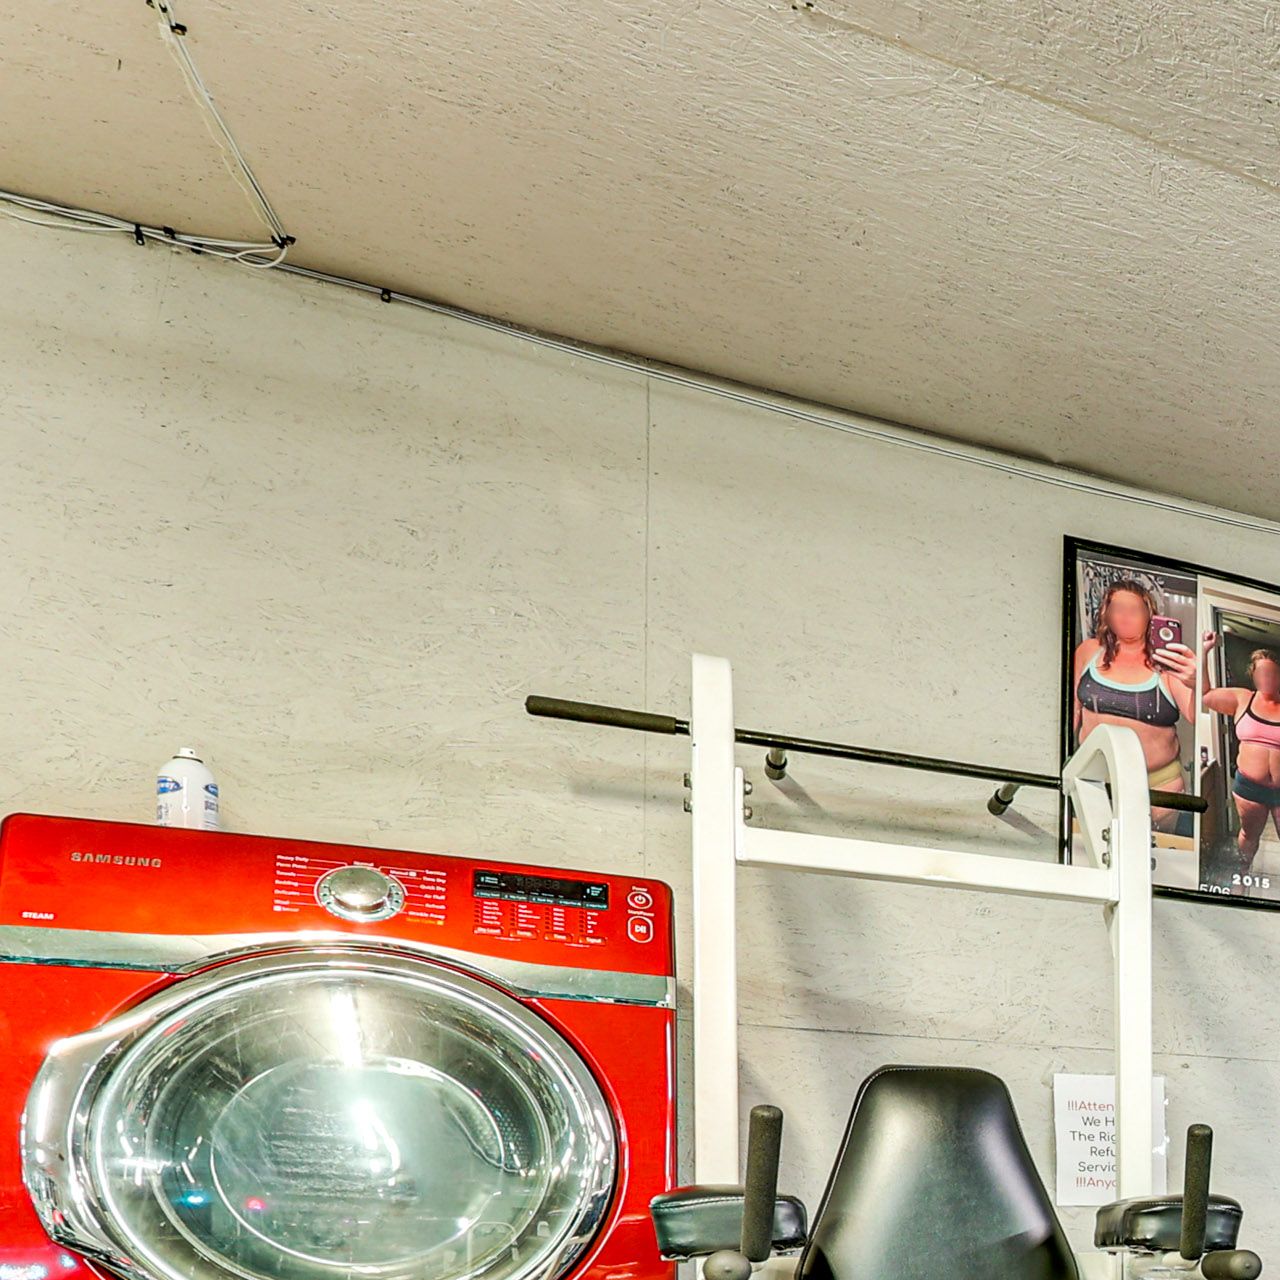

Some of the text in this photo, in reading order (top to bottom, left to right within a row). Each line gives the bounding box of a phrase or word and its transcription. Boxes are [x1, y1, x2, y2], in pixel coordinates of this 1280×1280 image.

[71, 852, 161, 867] SAMSUNG
[1232, 874, 1270, 889] 2015
[22, 911, 54, 920] STEAM
[1068, 1101, 1115, 1111] !!!Atten
[1082, 1116, 1100, 1126] We
[1070, 1131, 1116, 1144] The Rig
[1090, 1146, 1116, 1157] Refu
[1078, 1161, 1116, 1172] Servic
[1076, 1177, 1116, 1190] !!!Anyo
